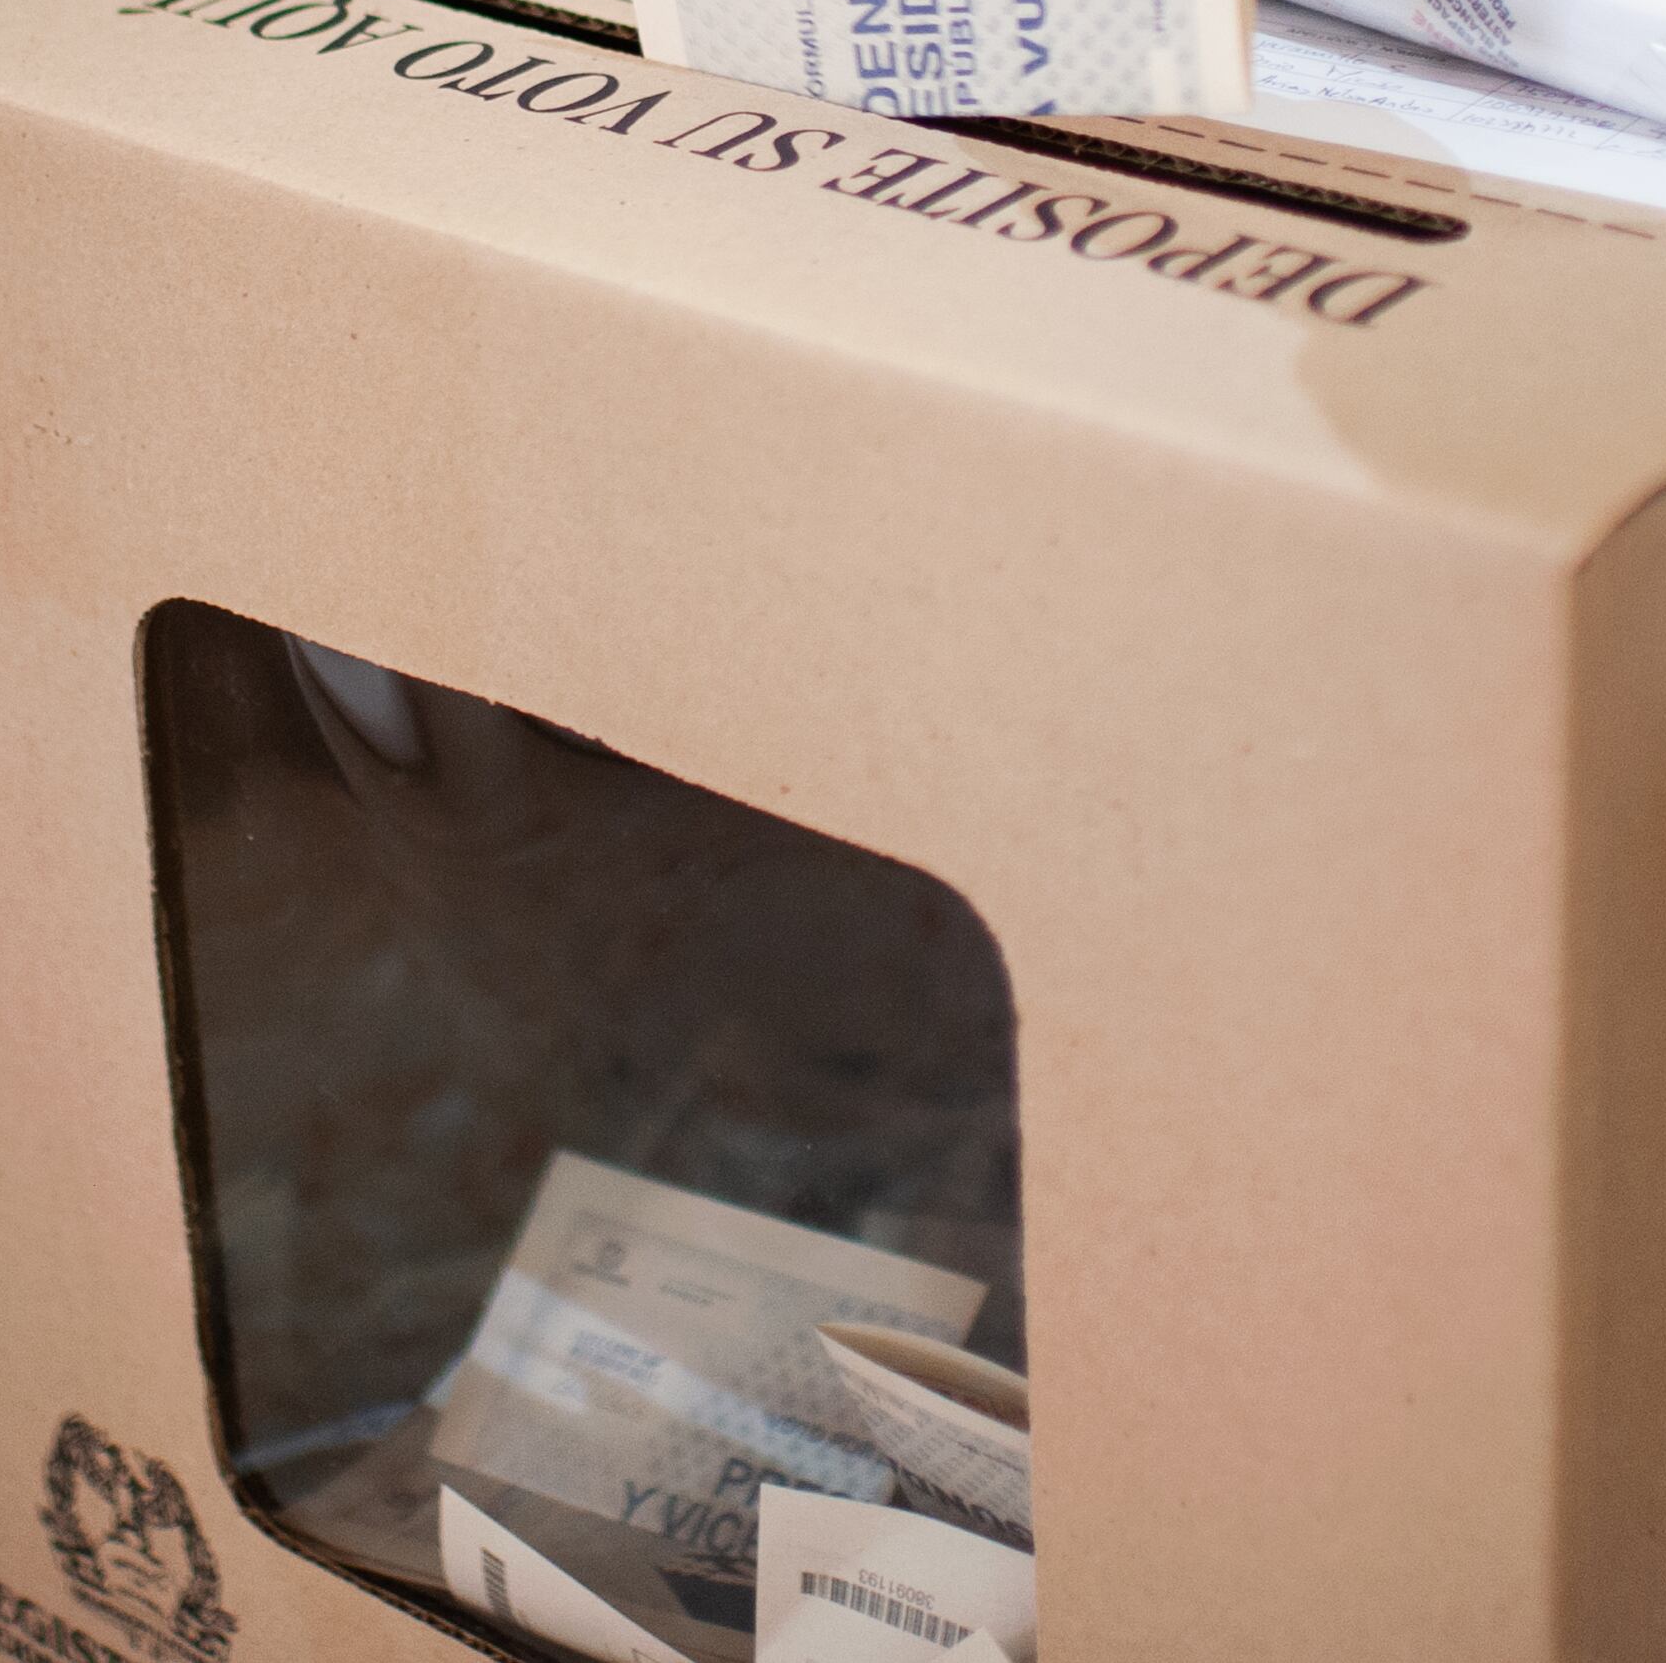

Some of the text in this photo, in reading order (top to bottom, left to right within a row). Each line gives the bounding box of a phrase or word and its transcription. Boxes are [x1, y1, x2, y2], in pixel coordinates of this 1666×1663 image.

[393, 39, 672, 136] VOTO
[653, 110, 847, 173] SU
[819, 148, 1433, 330] DEPOSITE
[859, 1568, 935, 1612] 38091193
